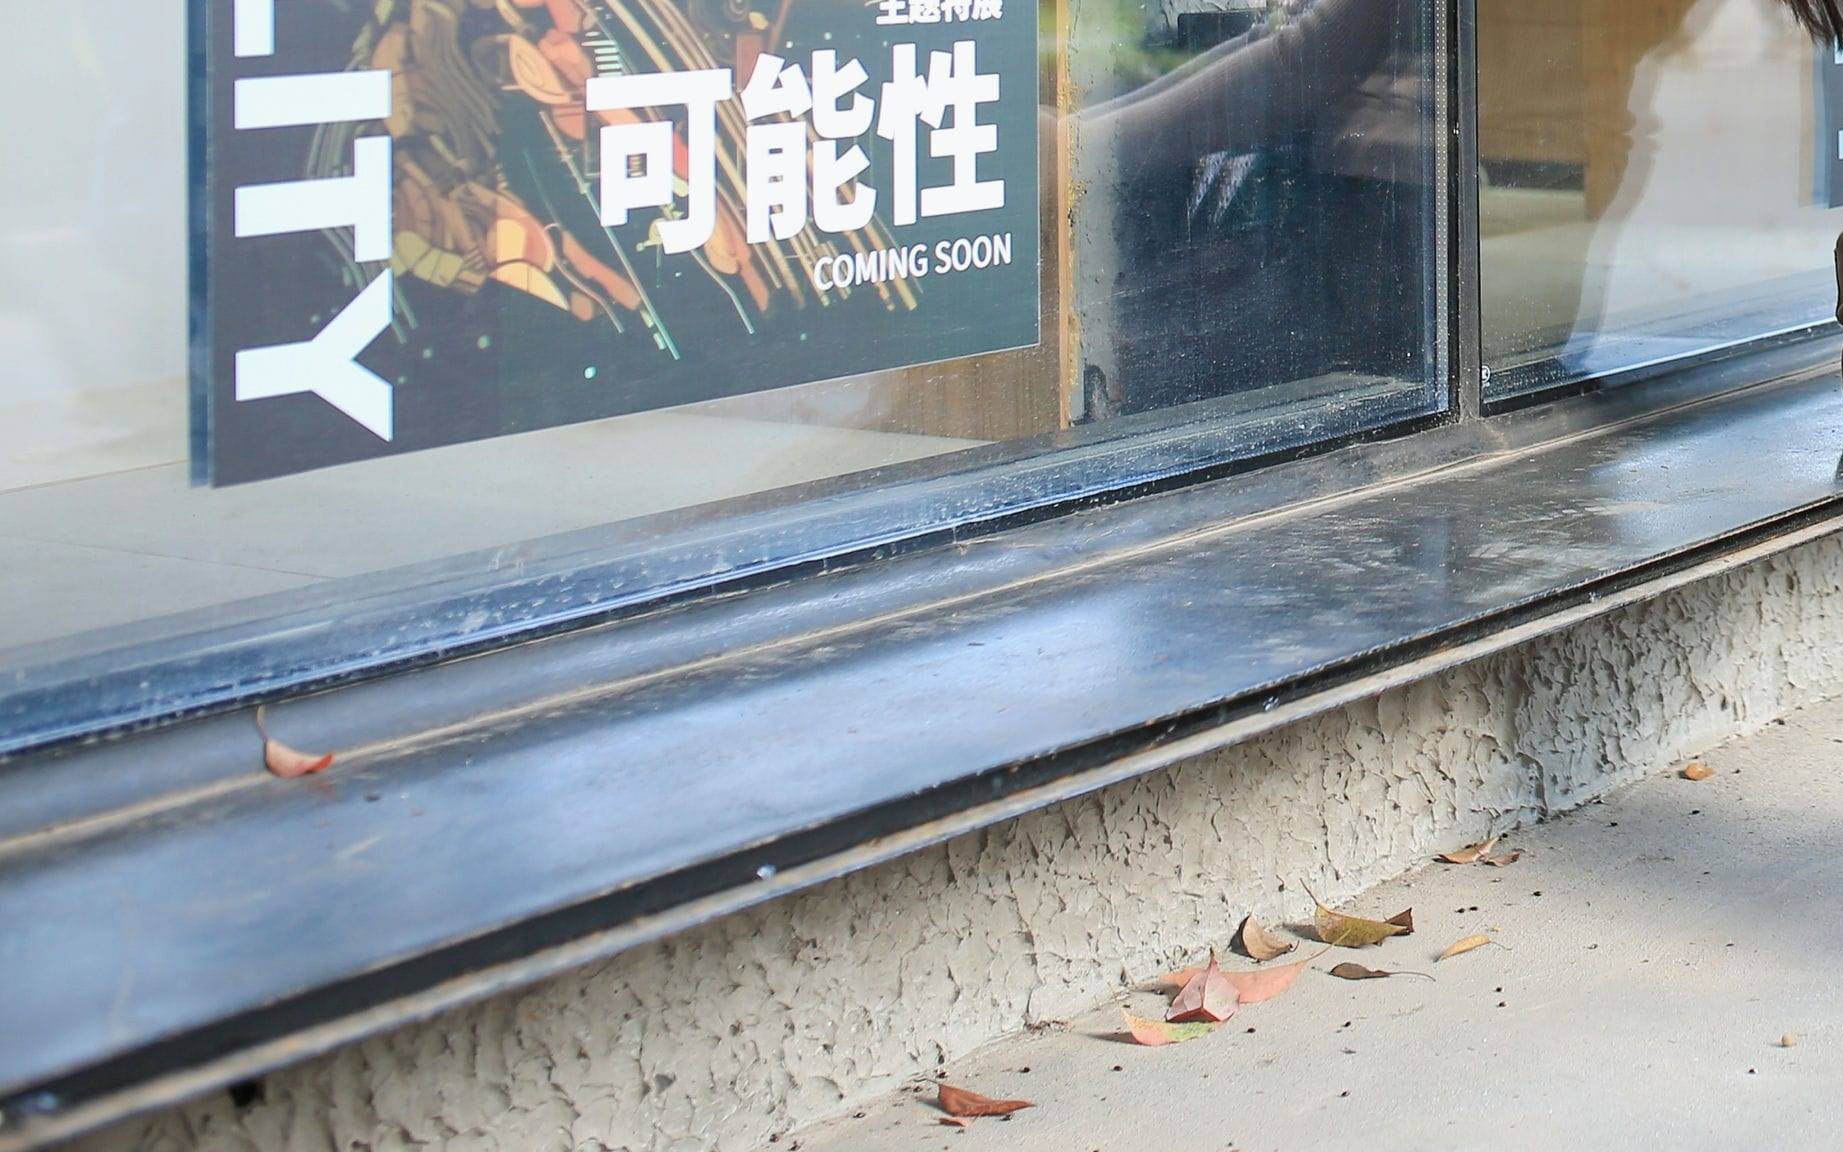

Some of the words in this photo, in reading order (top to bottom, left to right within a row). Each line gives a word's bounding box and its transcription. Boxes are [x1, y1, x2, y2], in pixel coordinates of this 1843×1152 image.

[585, 40, 1006, 255] 可能性
[813, 247, 929, 290] COMING
[934, 232, 1013, 274] SOON
